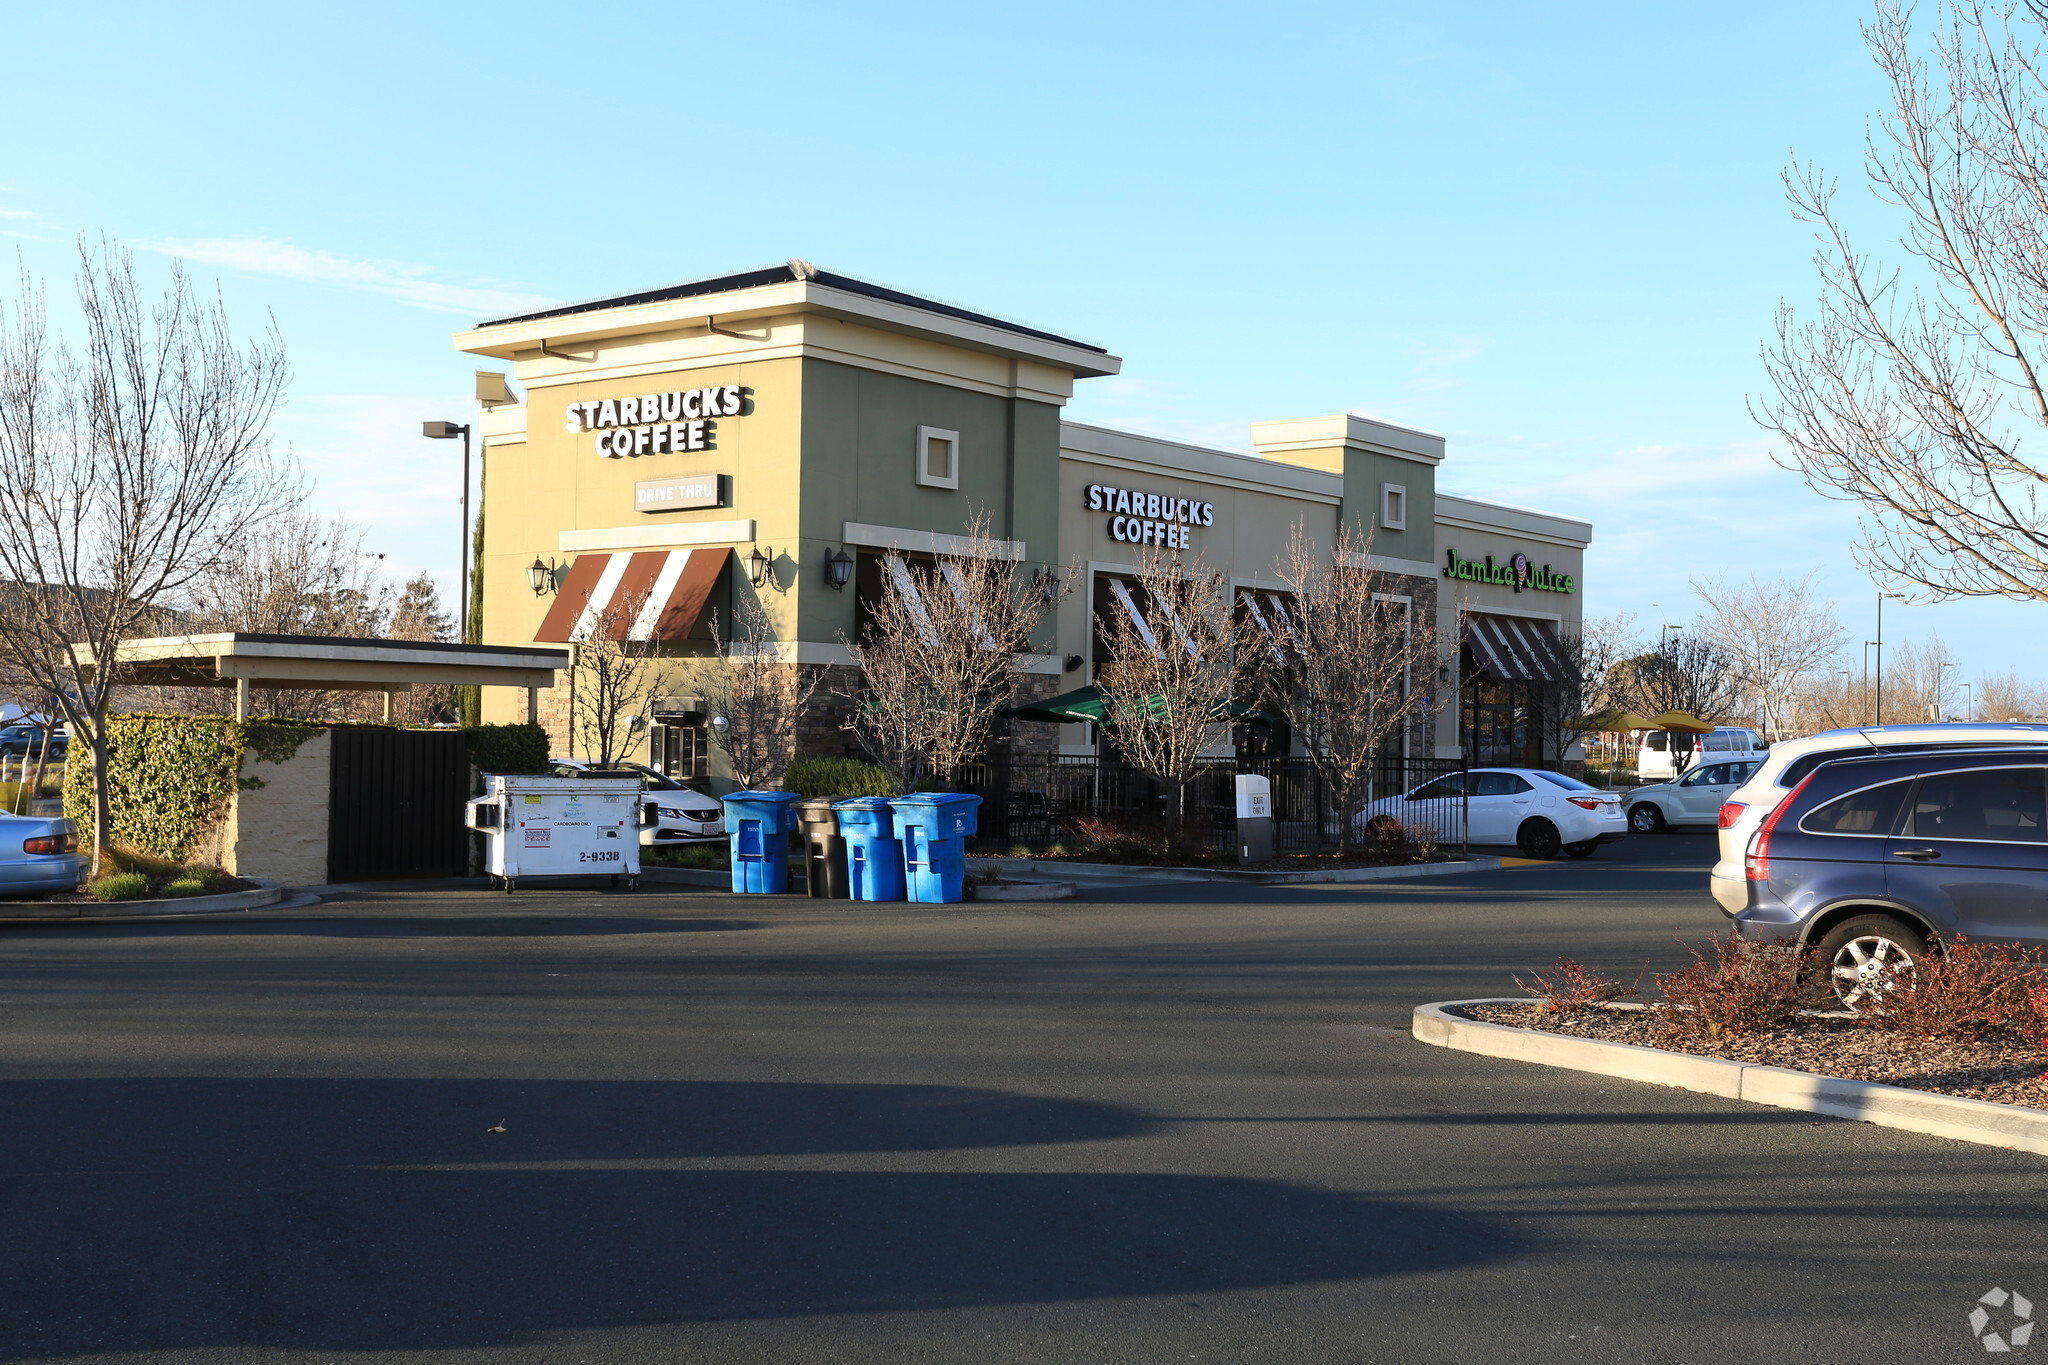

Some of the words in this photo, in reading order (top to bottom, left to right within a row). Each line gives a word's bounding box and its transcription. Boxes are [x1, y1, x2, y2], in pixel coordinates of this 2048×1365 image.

[566, 384, 741, 434] STARBUCKS
[595, 420, 705, 458] COFFEE
[638, 486, 674, 504] DRIVE
[678, 483, 713, 500] THRU
[1089, 484, 1215, 527] STARBUCKS
[1112, 515, 1190, 550] COFFEE
[1446, 548, 1516, 586] Jamba
[1526, 561, 1577, 593] Juice
[1252, 806, 1265, 815] ONLY
[1253, 796, 1264, 805] EXIT
[579, 851, 620, 862] 2-9338
